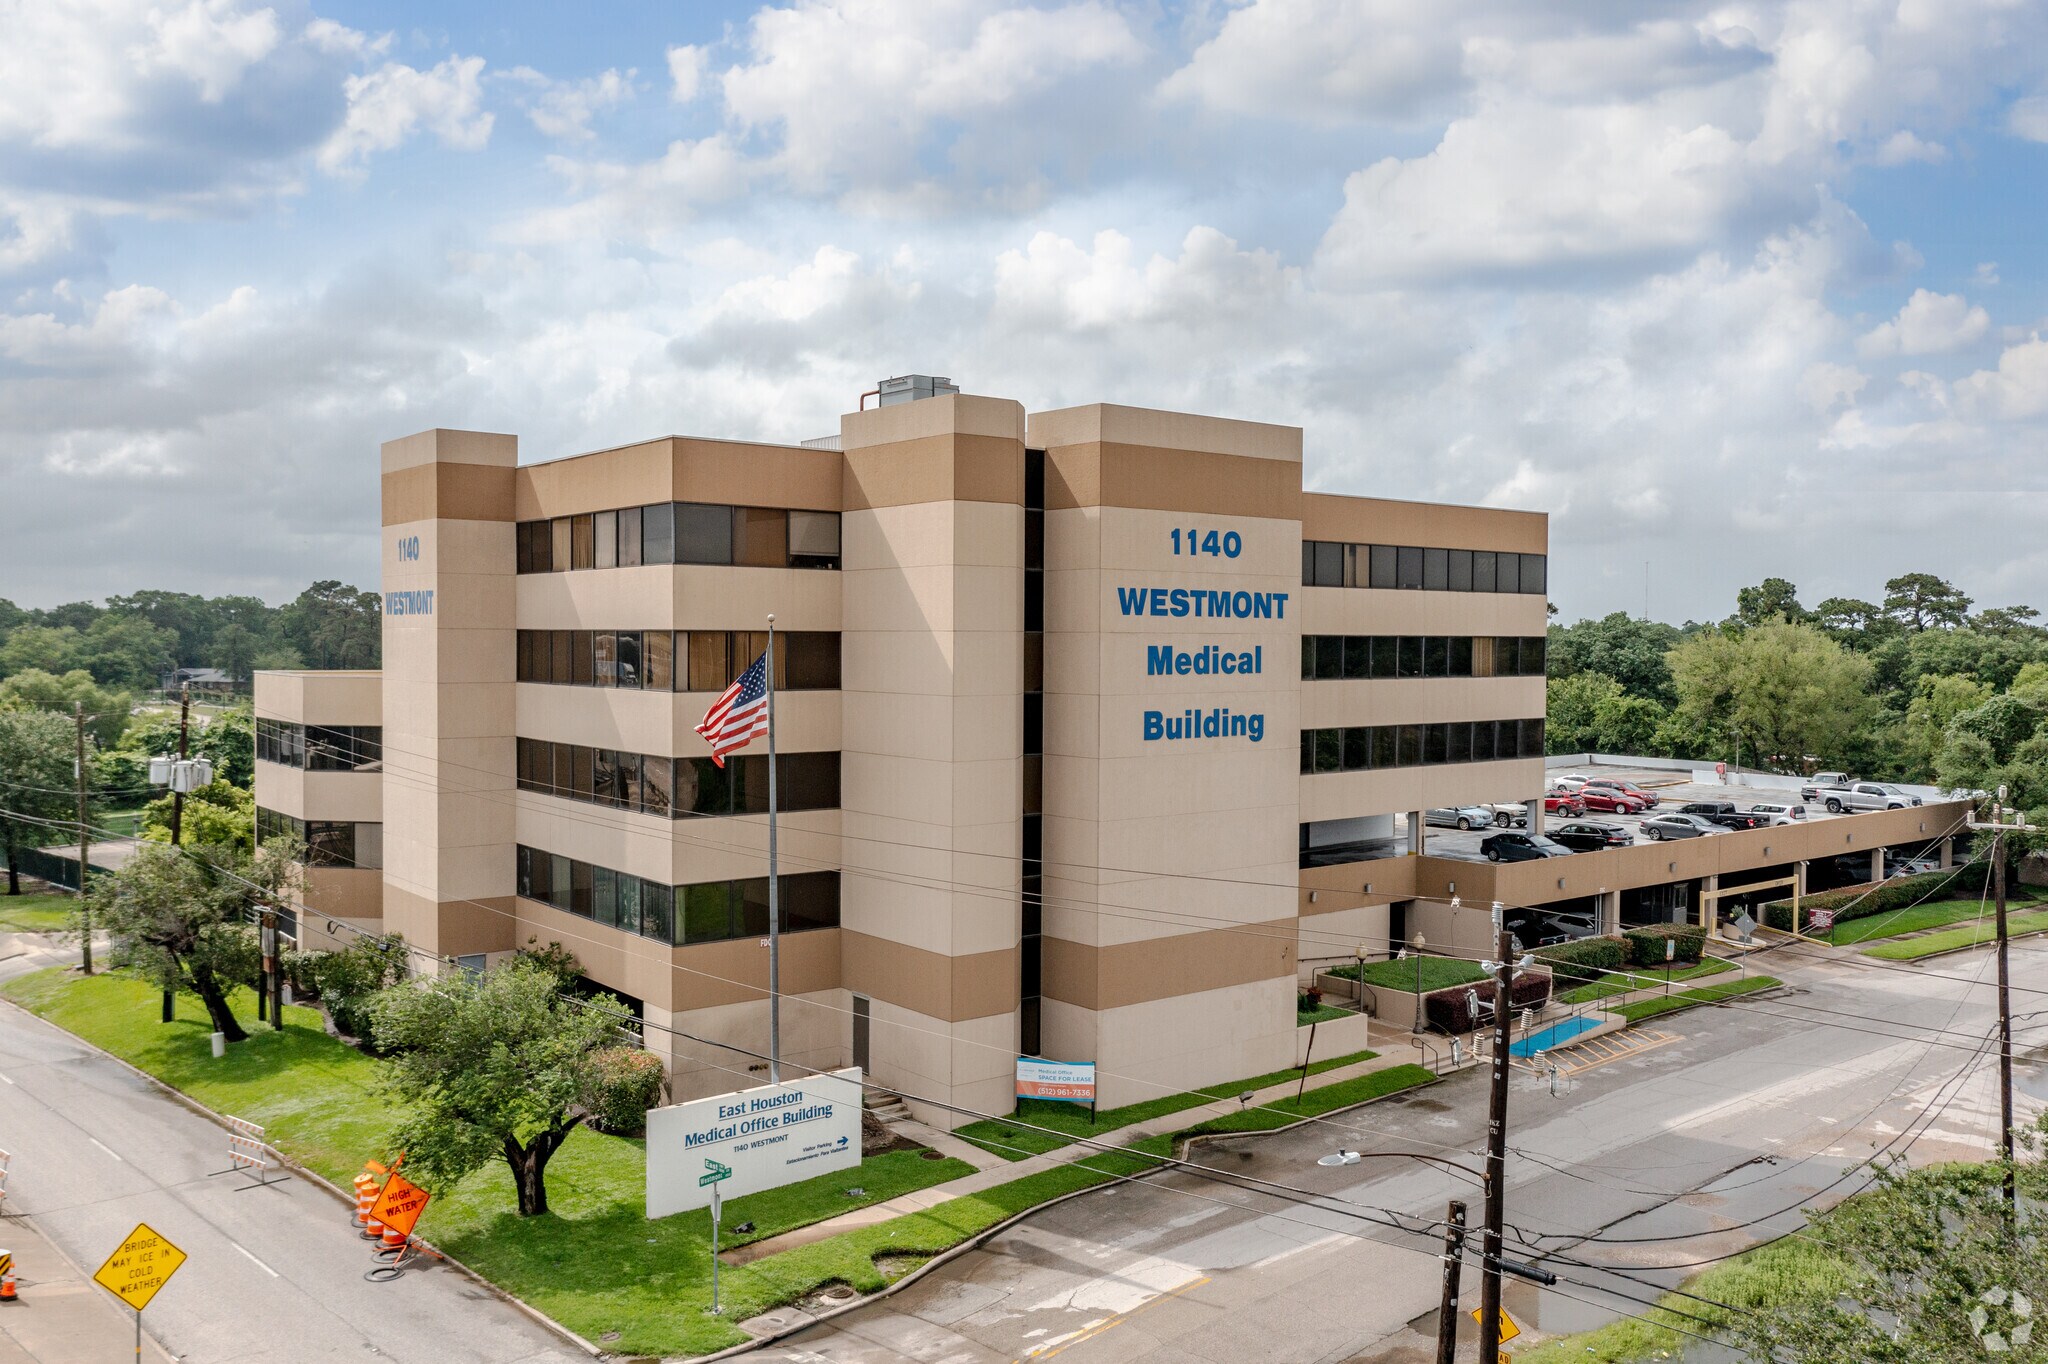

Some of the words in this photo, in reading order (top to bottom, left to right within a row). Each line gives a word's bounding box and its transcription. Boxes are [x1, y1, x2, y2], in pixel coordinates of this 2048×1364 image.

[398, 536, 420, 562] 1140
[1171, 528, 1242, 558] 1140
[385, 590, 434, 616] WESTMONT
[1117, 587, 1289, 619] WESTMONT
[1147, 645, 1262, 676] Medical
[1143, 708, 1265, 742] Building
[1037, 1087, 1056, 1096] (512)
[719, 1101, 746, 1119] East
[750, 1091, 803, 1112] Houston
[685, 1124, 737, 1147] Medical
[740, 1115, 779, 1134] Office
[783, 1104, 833, 1125] Building
[734, 1143, 749, 1153] 1140
[750, 1133, 789, 1149] WESTMONT
[706, 1160, 719, 1171] East
[700, 1172, 722, 1185] Westmont
[387, 1188, 411, 1203] HIGH
[385, 1200, 417, 1217] WATER
[125, 1237, 158, 1253] BRIDGE
[112, 1257, 132, 1269] MAY
[139, 1251, 154, 1263] ICE
[161, 1248, 171, 1258] IN
[129, 1265, 153, 1279] COLD
[120, 1276, 162, 1294] WEATHER
